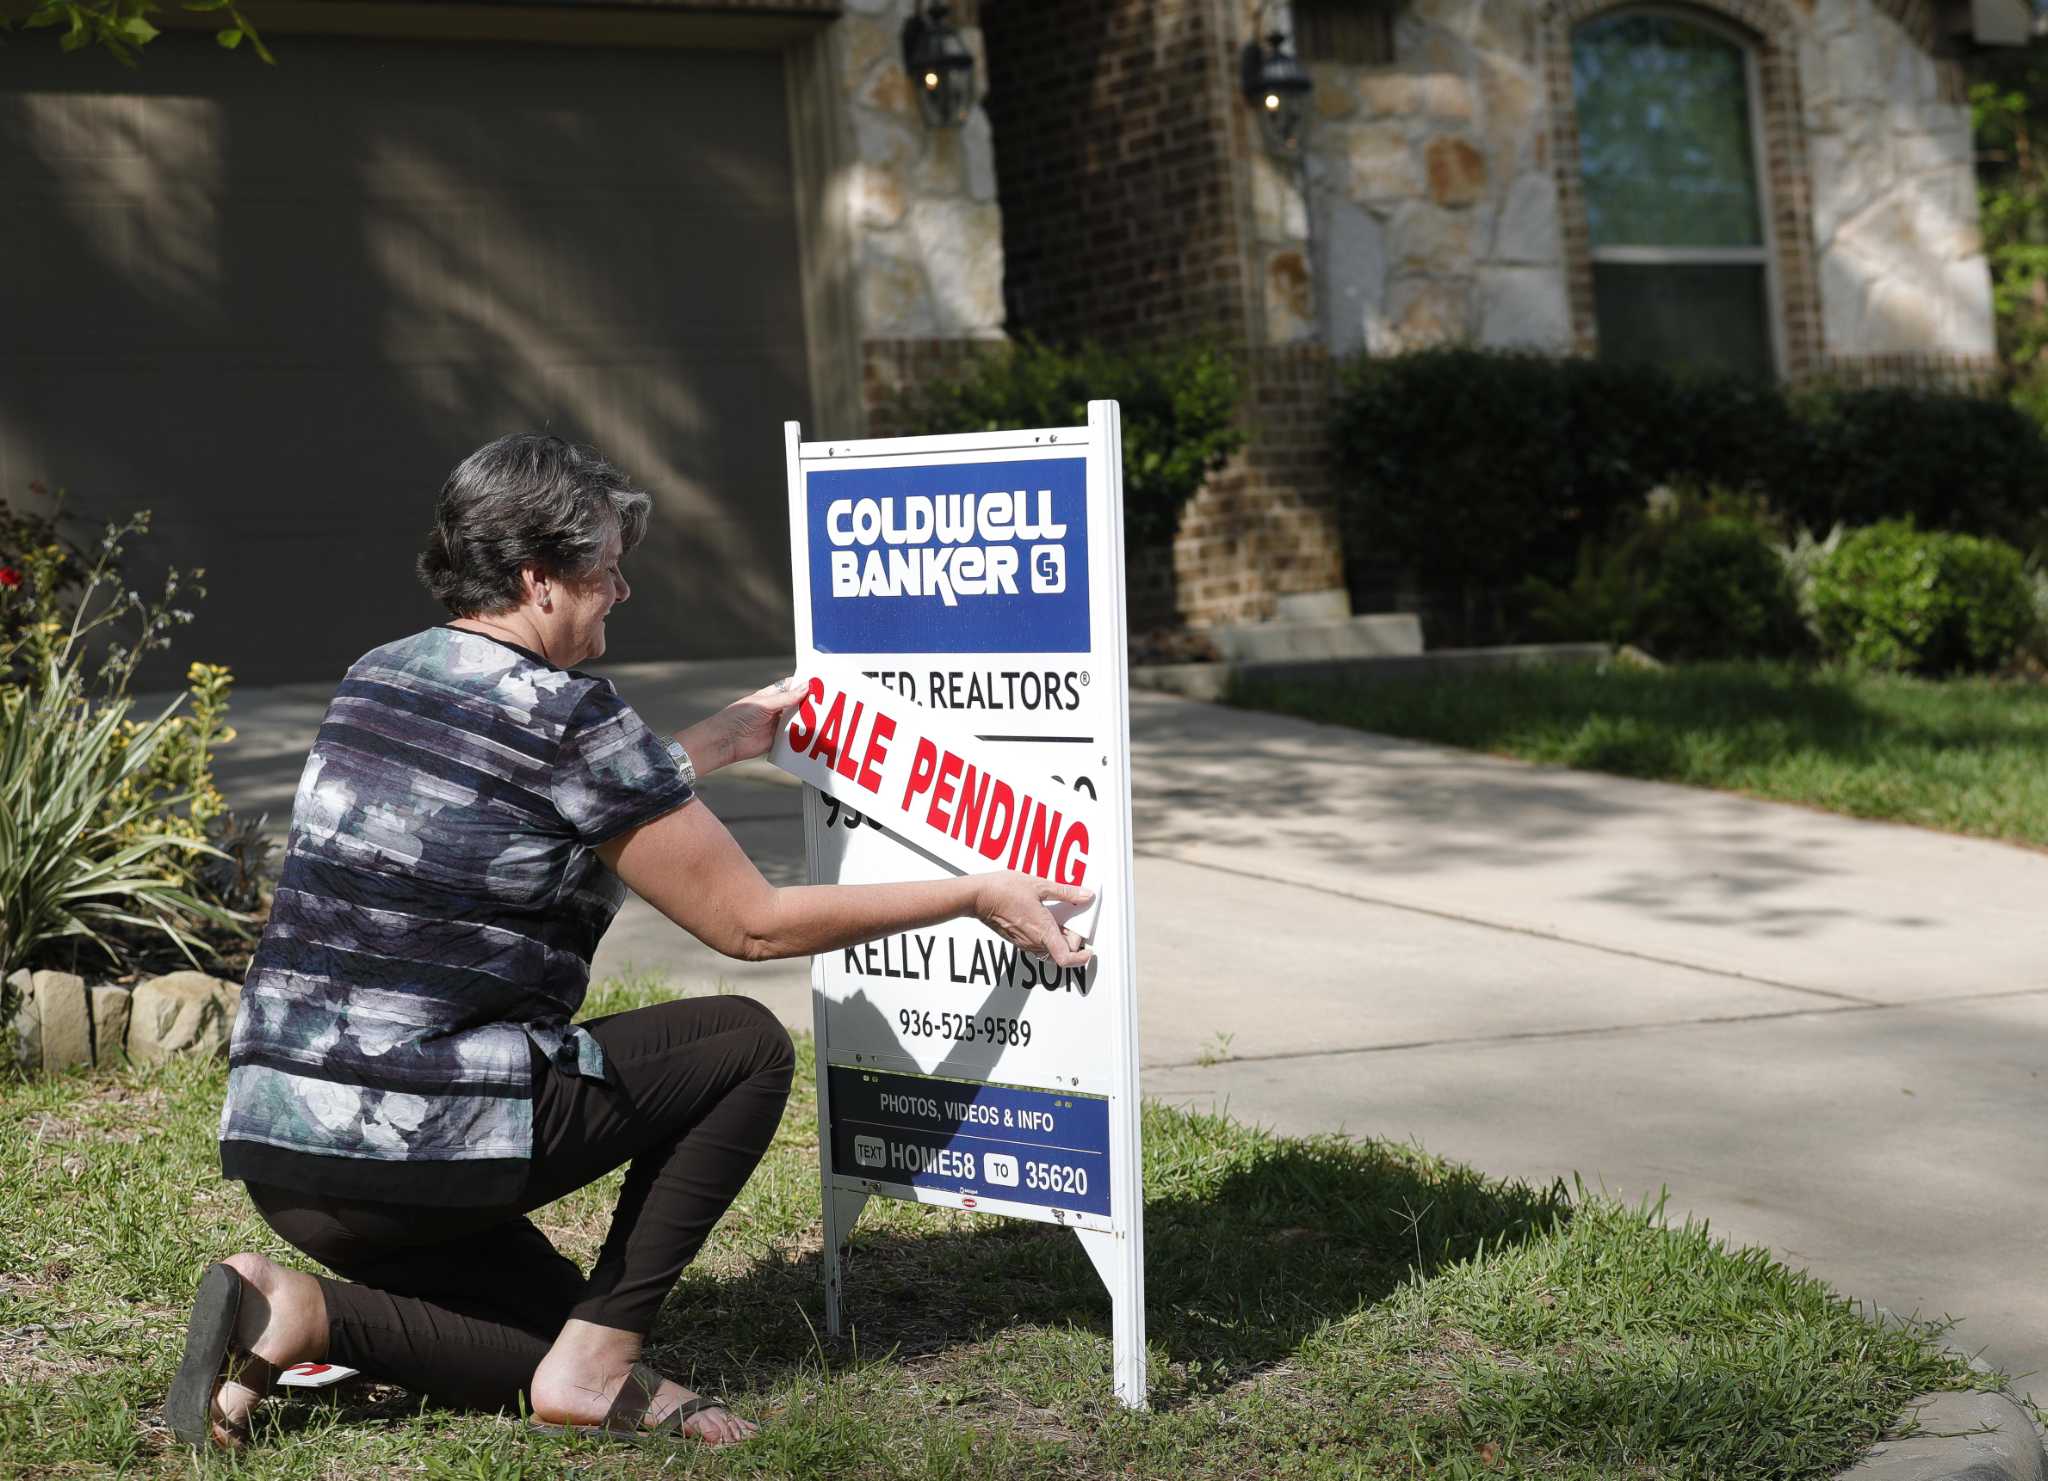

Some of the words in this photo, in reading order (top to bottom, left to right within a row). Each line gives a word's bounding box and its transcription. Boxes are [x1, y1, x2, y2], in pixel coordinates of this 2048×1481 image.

[788, 676, 897, 795] SALE
[901, 736, 1090, 888] PENDING
[843, 933, 936, 981] KELLY
[948, 936, 1087, 994] LAWSON
[899, 1008, 1032, 1047] 936-525-9589
[880, 1093, 942, 1121] PHOTOS,
[944, 1101, 1000, 1126] VIDEOS
[1003, 1109, 1014, 1128] &
[1018, 1110, 1054, 1132] INFO
[857, 1143, 884, 1161] TEXT
[890, 1142, 976, 1180] HOME58
[993, 1162, 1009, 1178] TO
[1025, 1161, 1088, 1196] 35620
